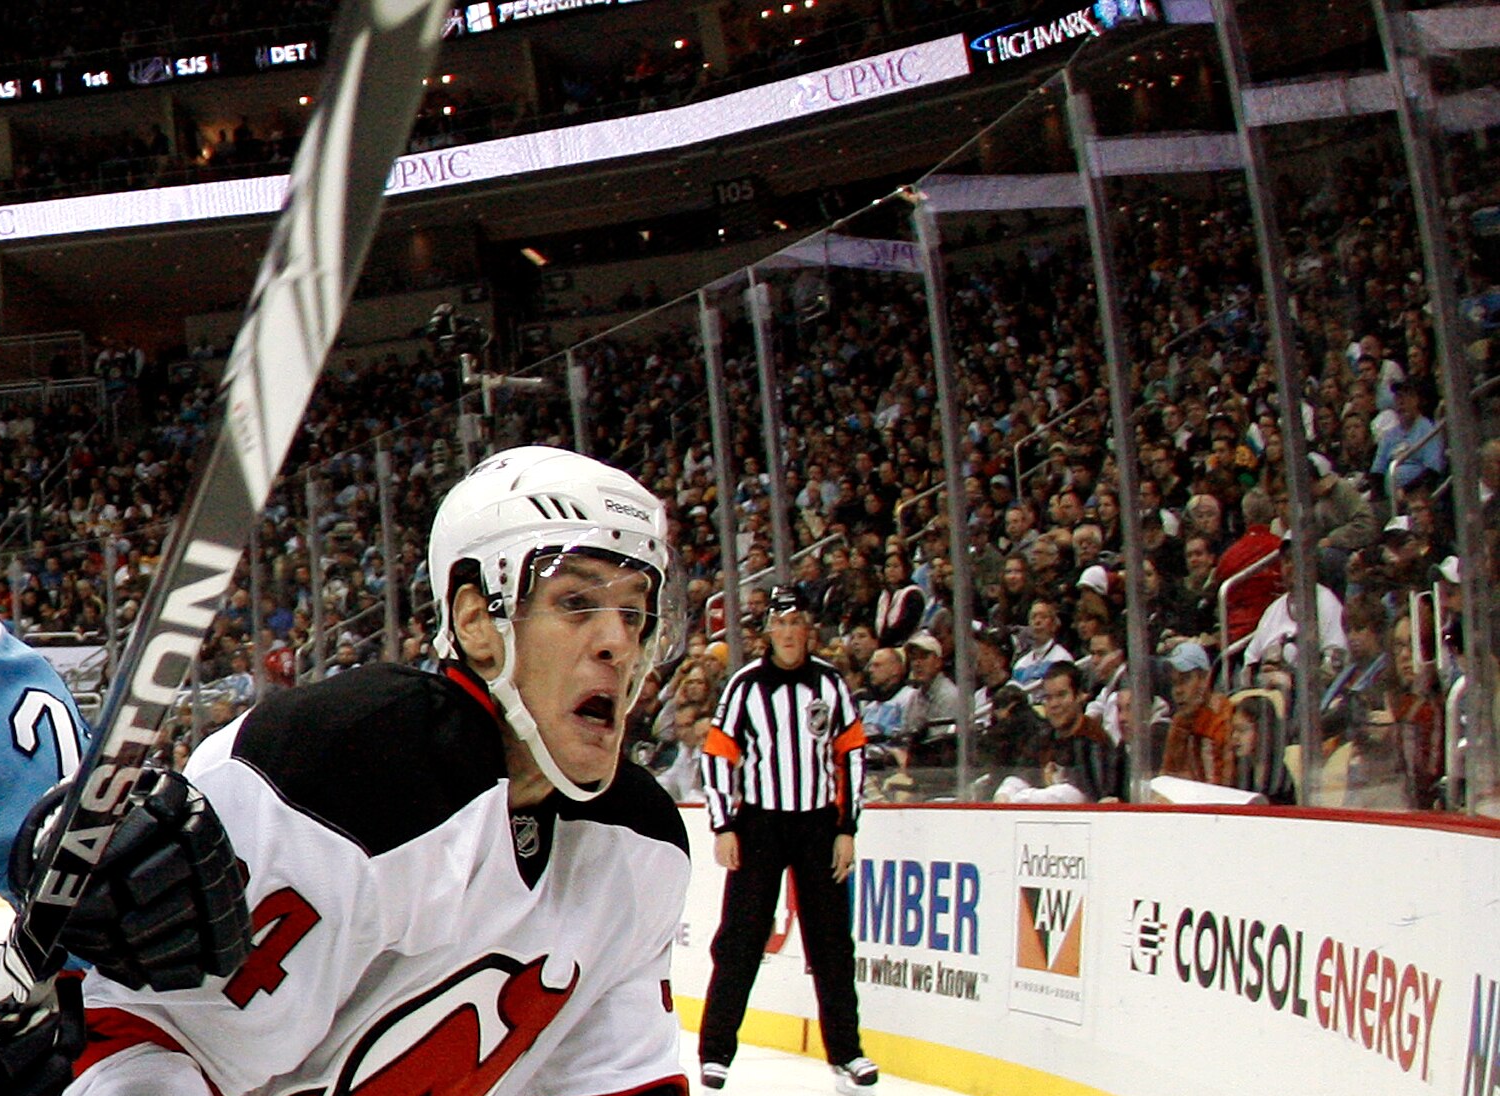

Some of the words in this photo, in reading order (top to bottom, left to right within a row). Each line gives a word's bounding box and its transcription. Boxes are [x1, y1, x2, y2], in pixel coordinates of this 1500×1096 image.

[32, 79, 43, 93] 1
[82, 71, 109, 87] 1st
[176, 56, 209, 75] SJS
[270, 44, 308, 64] DET
[822, 50, 922, 102] UPMC
[604, 499, 651, 524] Reebok
[37, 539, 243, 908] EASTON
[1018, 843, 1087, 880] Andersen
[851, 859, 981, 955] MBER
[871, 954, 910, 990] what
[912, 960, 933, 994] we
[937, 959, 980, 1002] know.
[1174, 906, 1308, 1018] CONSOL
[1315, 936, 1443, 1083] ENERGY
